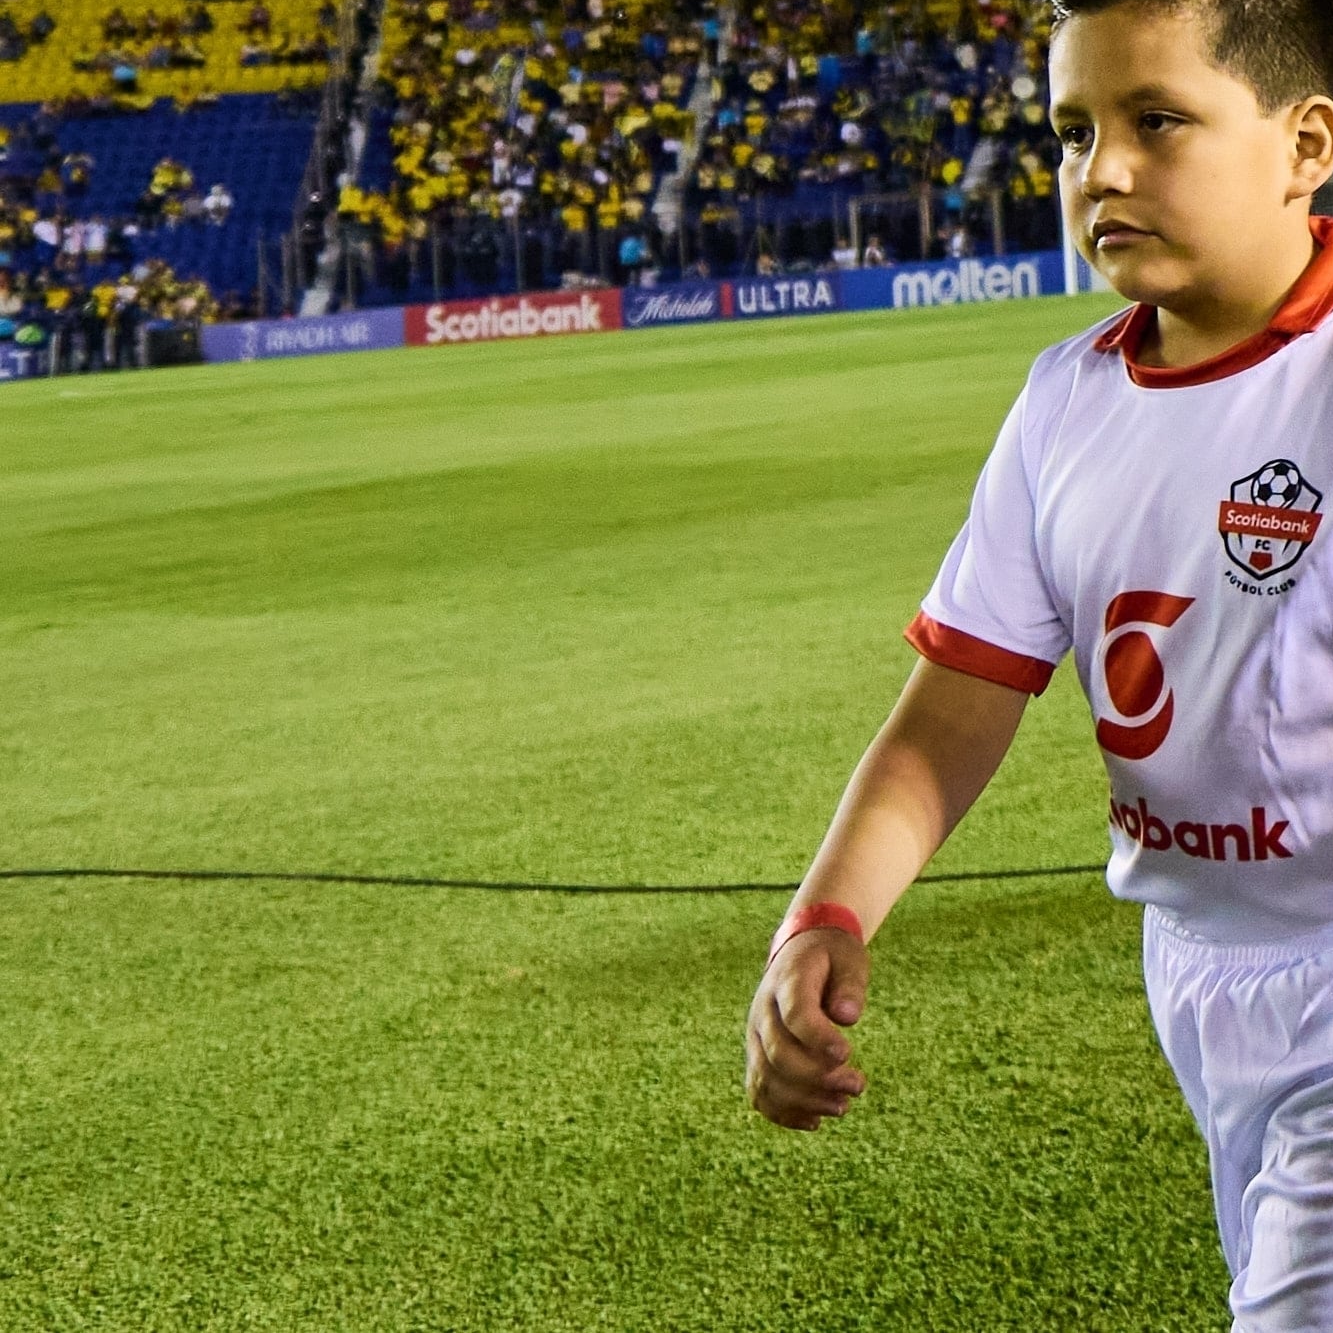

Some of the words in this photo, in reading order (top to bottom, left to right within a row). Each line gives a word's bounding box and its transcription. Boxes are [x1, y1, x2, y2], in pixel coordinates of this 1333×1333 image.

[738, 279, 833, 313] ULTRA
[892, 259, 1039, 308] molten
[425, 294, 601, 343] Scotiabank
[1224, 509, 1311, 534] Scotiabank
[1254, 539, 1272, 551] FC
[1266, 578, 1297, 596] CLUB
